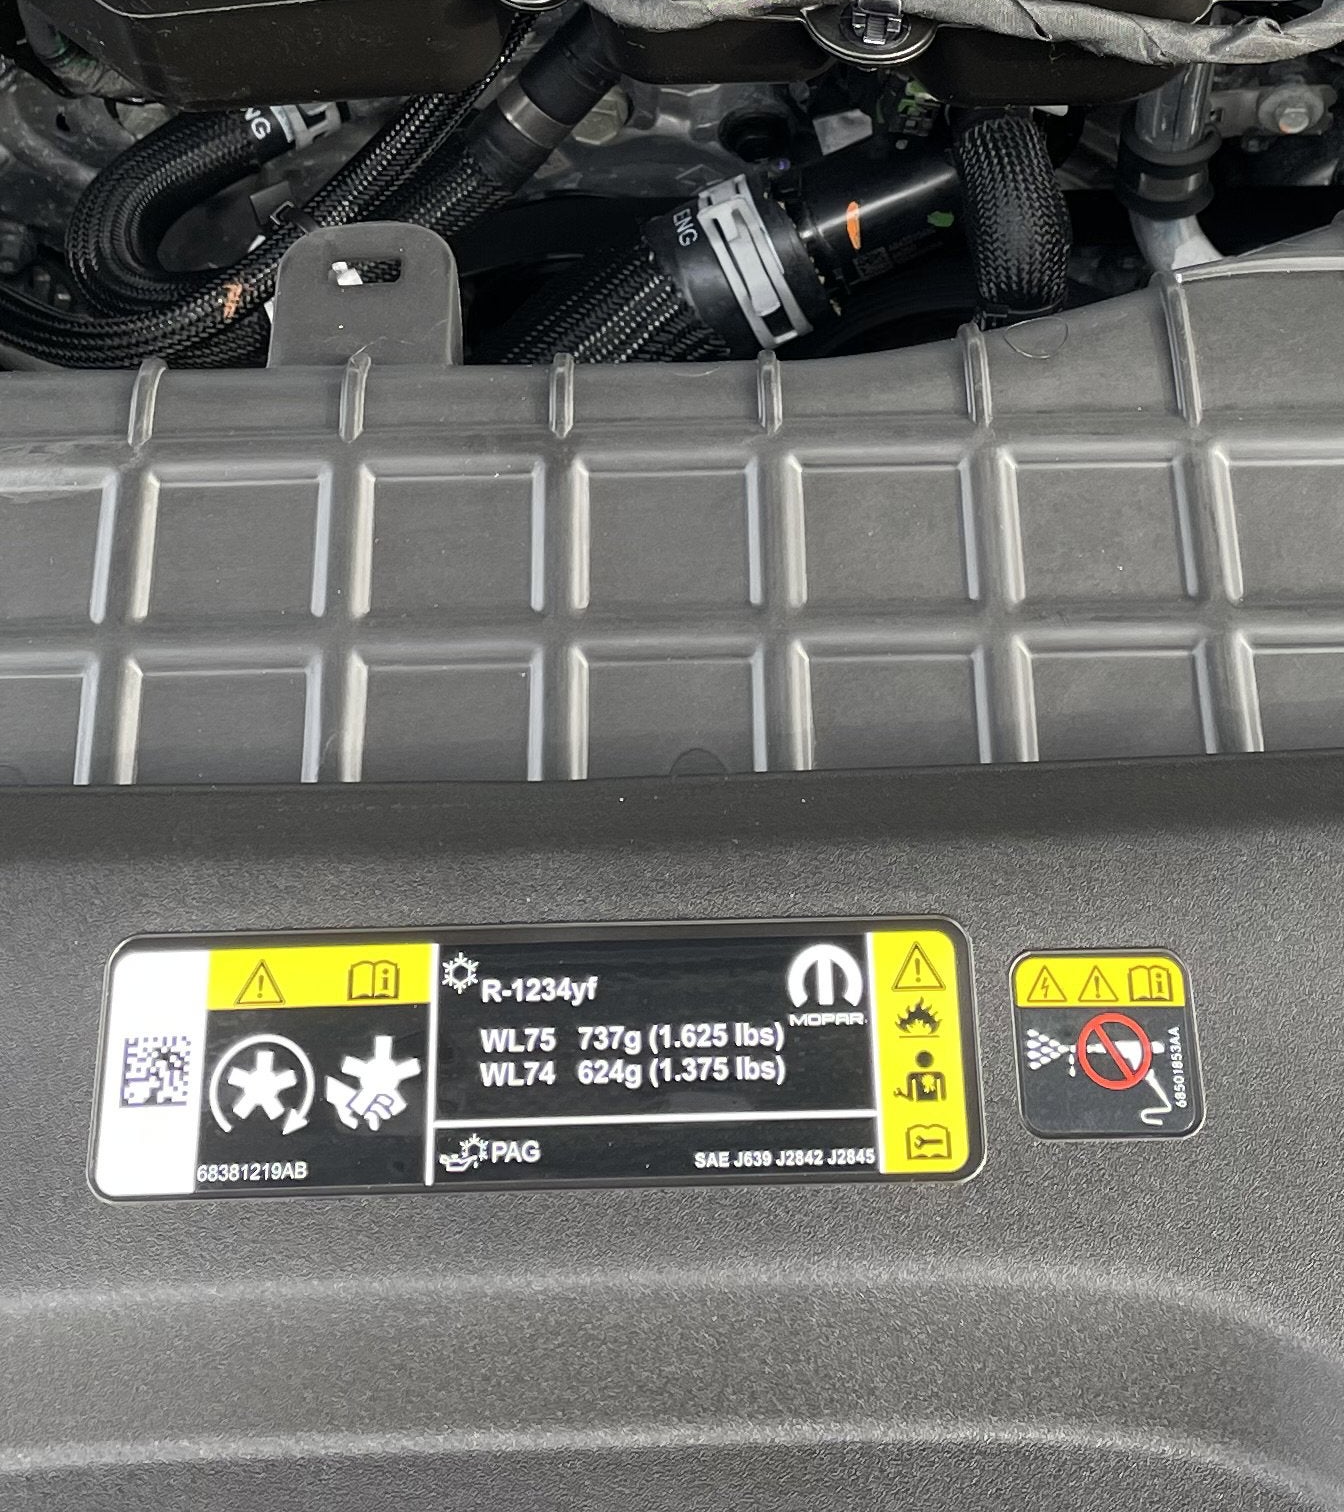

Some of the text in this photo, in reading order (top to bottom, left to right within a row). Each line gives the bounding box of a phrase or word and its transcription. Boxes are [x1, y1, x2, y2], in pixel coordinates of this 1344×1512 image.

[673, 208, 698, 246] ENG
[481, 976, 598, 1006] R-1234yf
[789, 1012, 864, 1027] MOPAR
[480, 1021, 785, 1055] WL75 737g (1.625 lbs)
[480, 1054, 786, 1089] WL74 624g (1.375 lbs)
[1167, 1026, 1187, 1108] 68501853AA
[491, 1140, 542, 1163] PAG
[694, 1148, 875, 1168] SAE J639 J2842 J2845
[197, 1161, 309, 1182] 68381219AB
